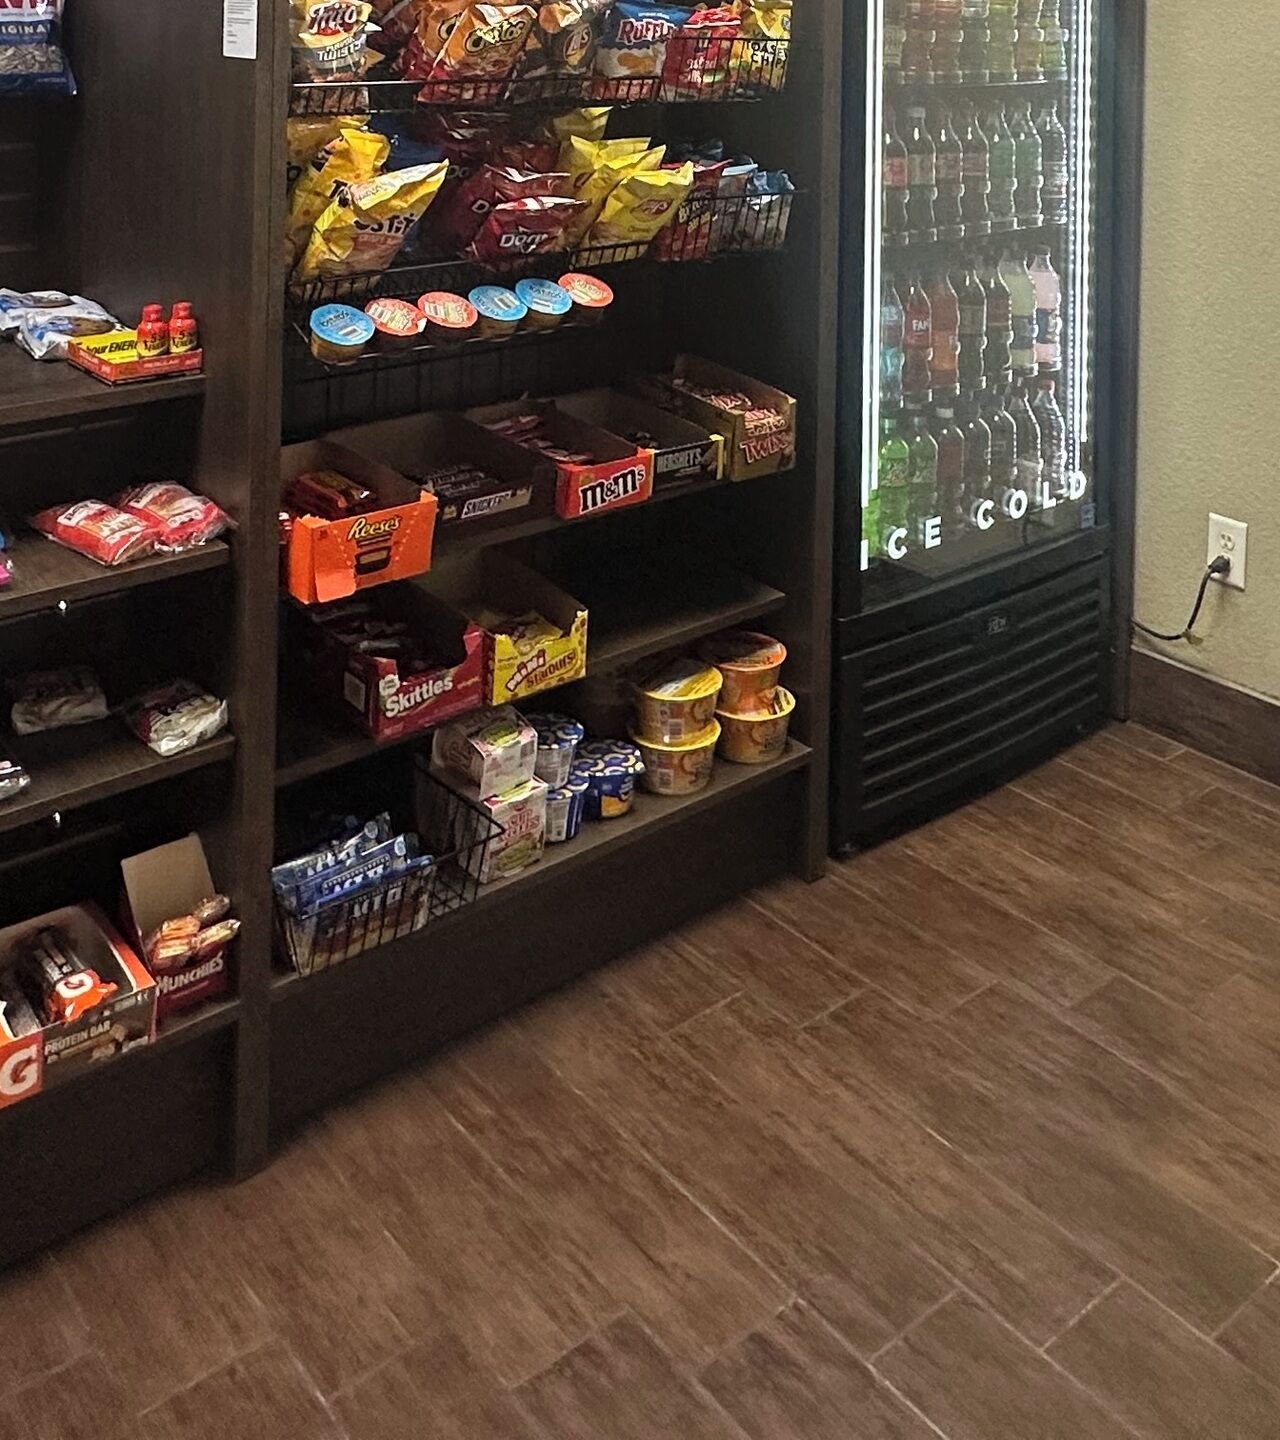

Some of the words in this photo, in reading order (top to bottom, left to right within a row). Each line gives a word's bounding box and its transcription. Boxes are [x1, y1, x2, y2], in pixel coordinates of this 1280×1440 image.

[108, 337, 138, 353] ENER
[347, 514, 403, 541] Reese's
[859, 515, 943, 572] ICE
[975, 469, 1087, 532] COLD
[384, 676, 454, 719] Skittles
[56, 970, 95, 999] G
[156, 951, 224, 997] MUNCHIES
[44, 1026, 91, 1056] PROTEIN
[91, 1020, 111, 1039] BAR
